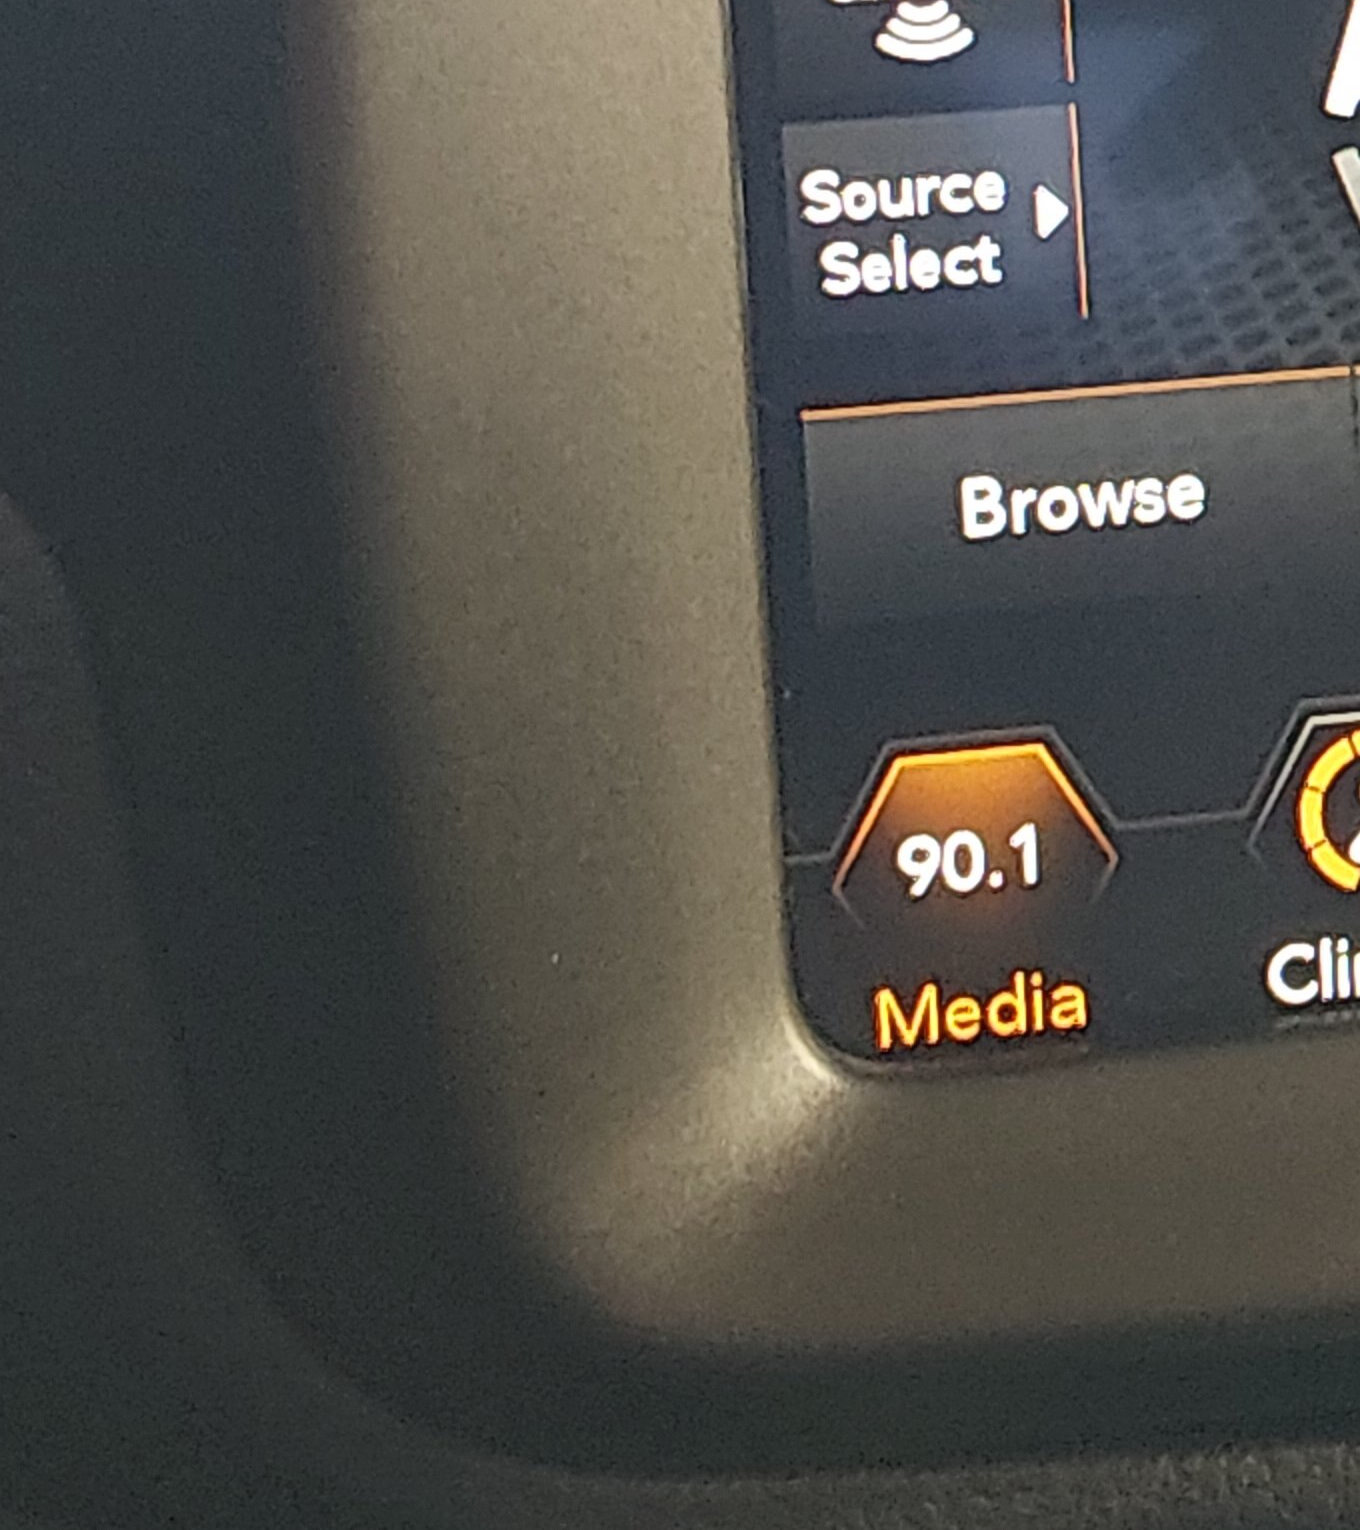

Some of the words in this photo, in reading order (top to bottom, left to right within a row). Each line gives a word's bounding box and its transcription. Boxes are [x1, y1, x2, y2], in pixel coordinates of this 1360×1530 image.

[800, 169, 1007, 224] Source
[820, 233, 1003, 296] Select
[960, 474, 1205, 539] Browse
[896, 819, 1038, 897] 90.1
[874, 971, 1087, 1050] Media
